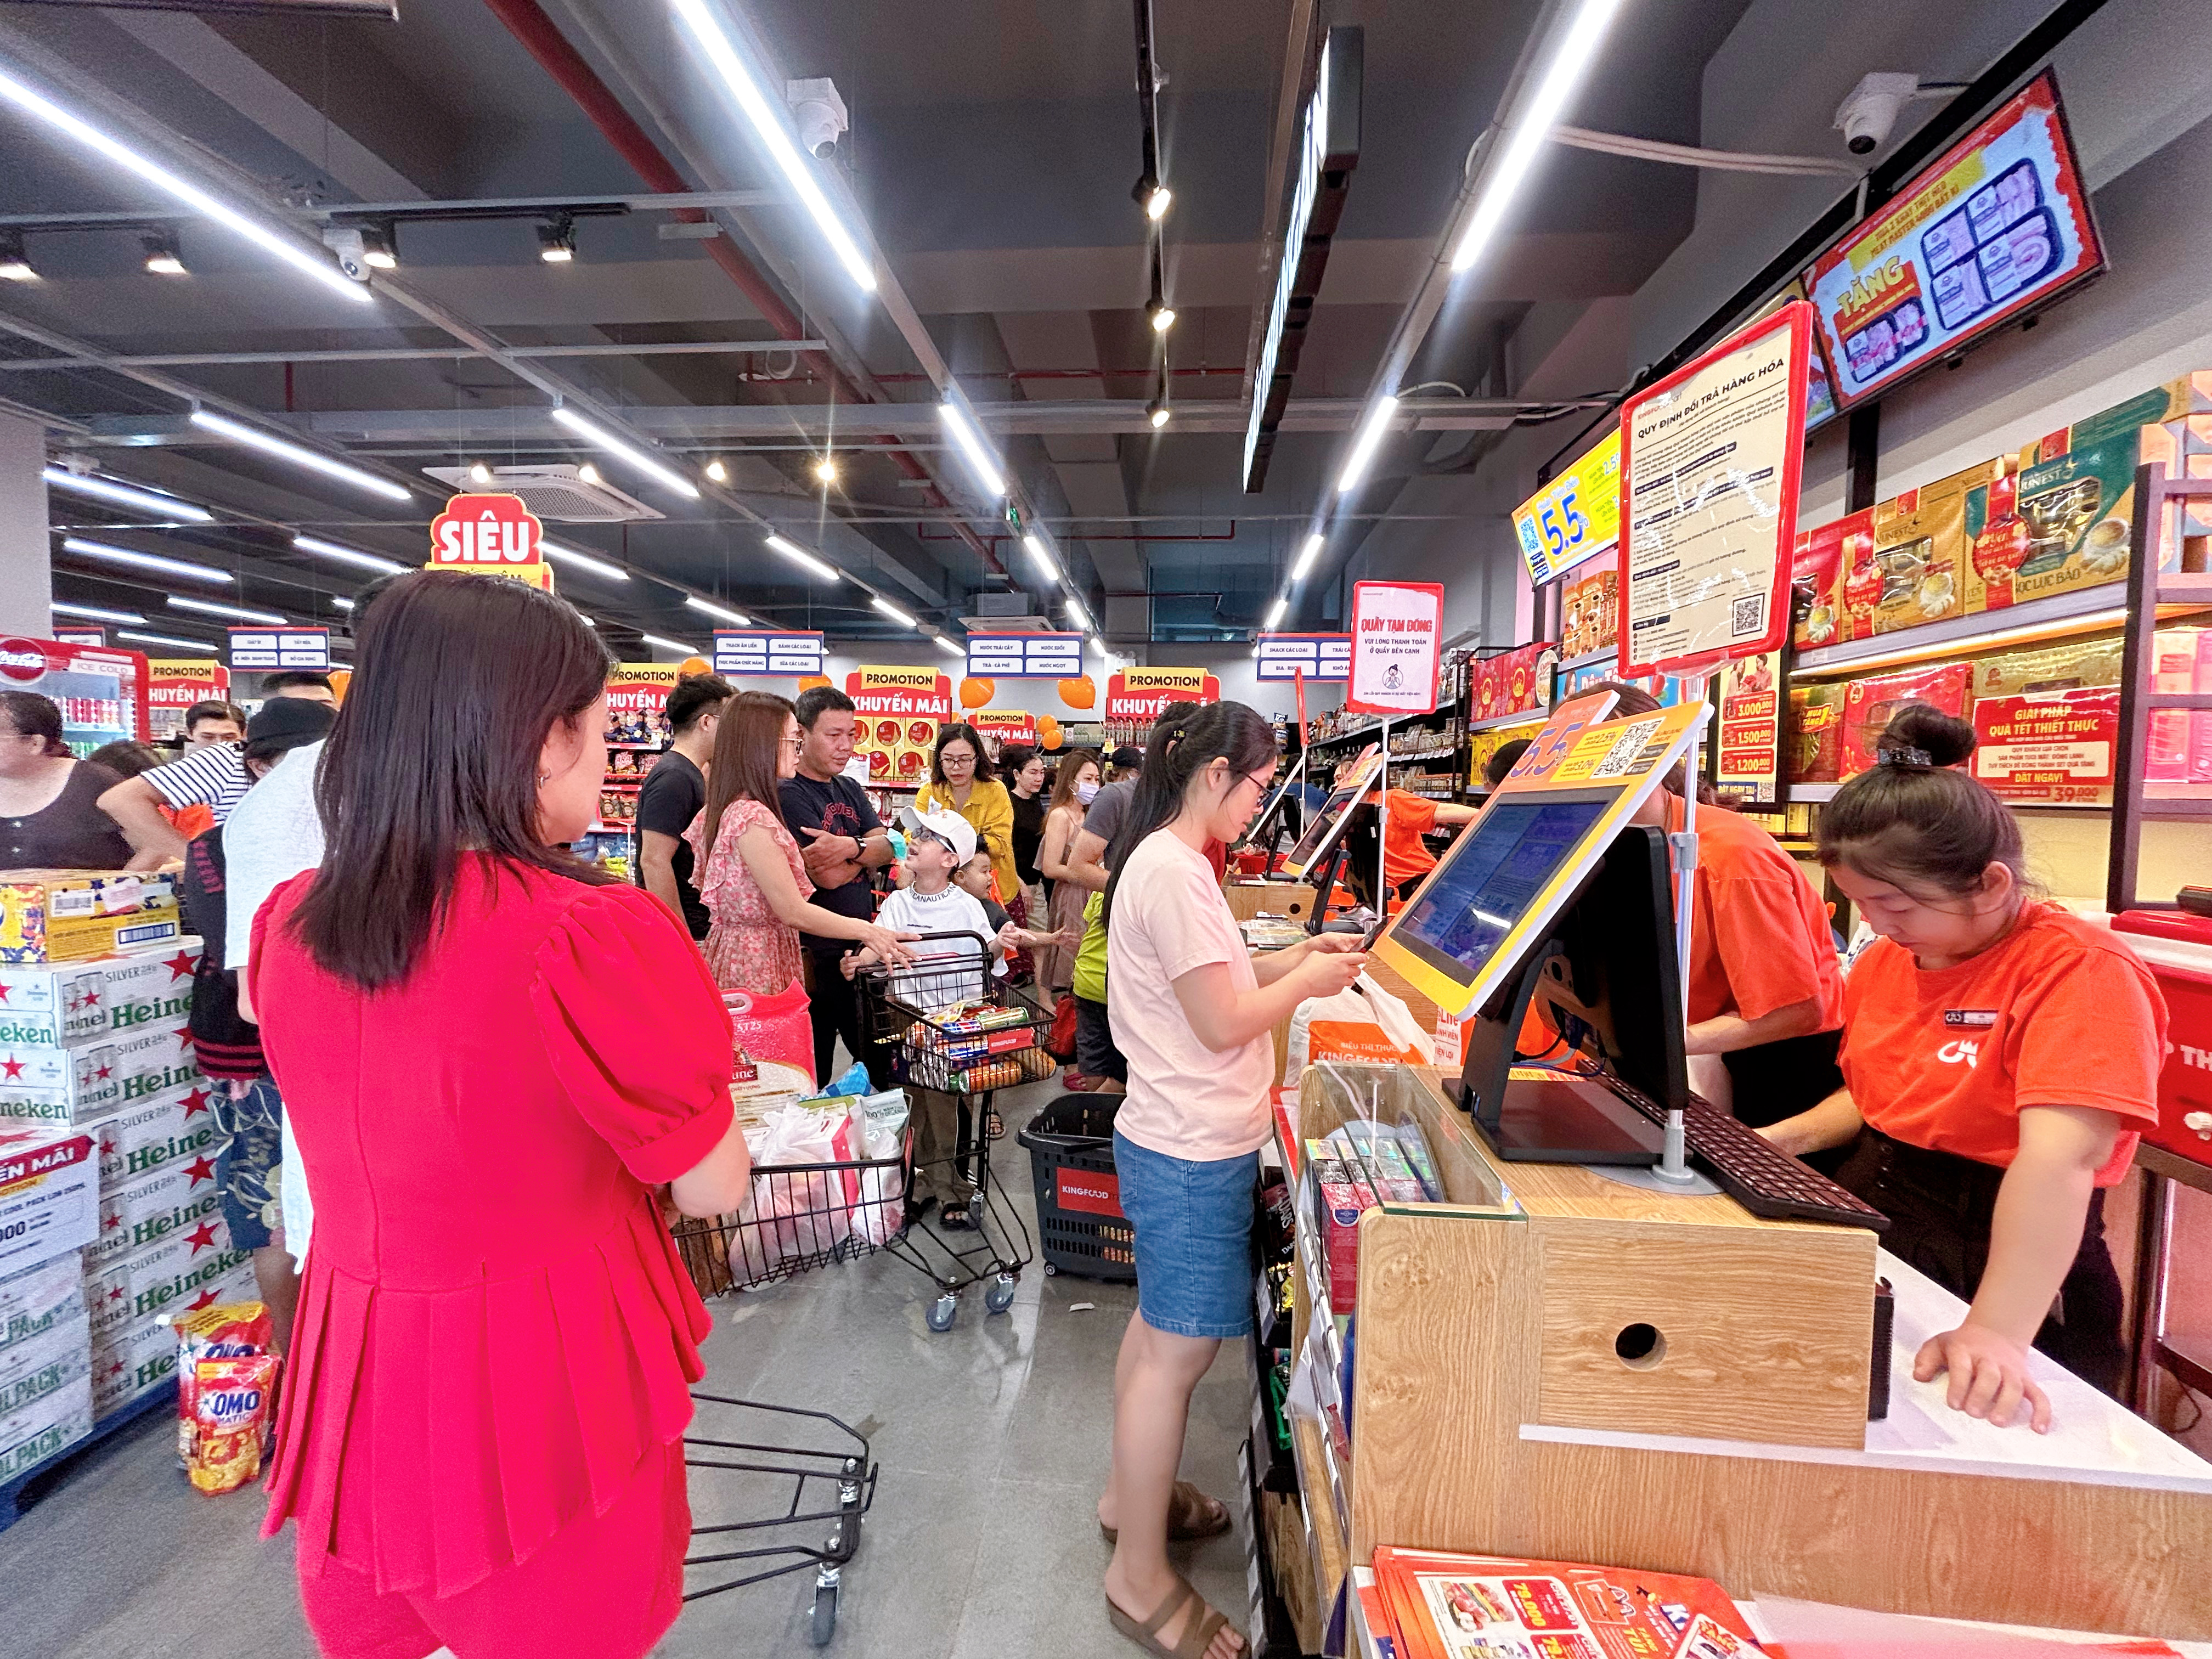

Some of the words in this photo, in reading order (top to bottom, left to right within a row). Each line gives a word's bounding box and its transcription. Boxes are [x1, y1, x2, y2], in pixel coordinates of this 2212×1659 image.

[1638, 424, 1657, 438] QUY
[1660, 413, 1682, 428] ĐỊNH
[1701, 387, 1719, 405] TRẢ
[1722, 372, 1755, 394] HÀNG
[1758, 358, 1784, 377] HÓA
[440, 510, 528, 562] SIÊU
[1392, 646, 1403, 654] BÊN
[1412, 637, 1426, 645] TOÁN
[99, 664, 128, 674] COLD
[154, 667, 211, 676] PROMOTION
[867, 674, 933, 685] PROMOTION
[1130, 675, 1200, 686] PROMOTION
[149, 684, 194, 702] HUYẾN
[198, 686, 225, 702] MÃI
[607, 688, 656, 708] HUYẾN
[850, 692, 912, 713] KHUYẾN
[916, 695, 947, 714] MÃI
[977, 726, 1011, 738] HUYẾN
[1013, 728, 1033, 740] MÃI
[1595, 731, 1618, 743] 2.5%
[1989, 723, 2011, 737] QUÀ
[2015, 720, 2031, 735] TẾT
[2035, 719, 2064, 733] THIẾT
[2068, 719, 2099, 734] THỰC
[2015, 772, 2031, 783] ĐẶT
[2034, 773, 2063, 783] NGAY!
[105, 967, 139, 983] SILVER
[111, 997, 193, 1030] Heine
[0, 1022, 53, 1043] eken
[737, 1021, 761, 1033] ST25
[117, 1037, 150, 1056] SILVER
[1340, 1042, 1358, 1051] SIÊU
[122, 1065, 201, 1101] Hein
[0, 1098, 69, 1119] neken
[121, 1111, 154, 1129] SILVER
[32, 1147, 75, 1172] MÃI
[126, 1128, 212, 1175] Heine
[127, 1181, 160, 1203] SILVER
[1062, 1186, 1109, 1199] KINGFOOD
[132, 1196, 218, 1246] Heine
[130, 1250, 162, 1273] SILVER
[214, 1391, 261, 1416] OMO
[217, 1413, 251, 1424] MATIC
[1513, 1582, 1547, 1627] 79.000
